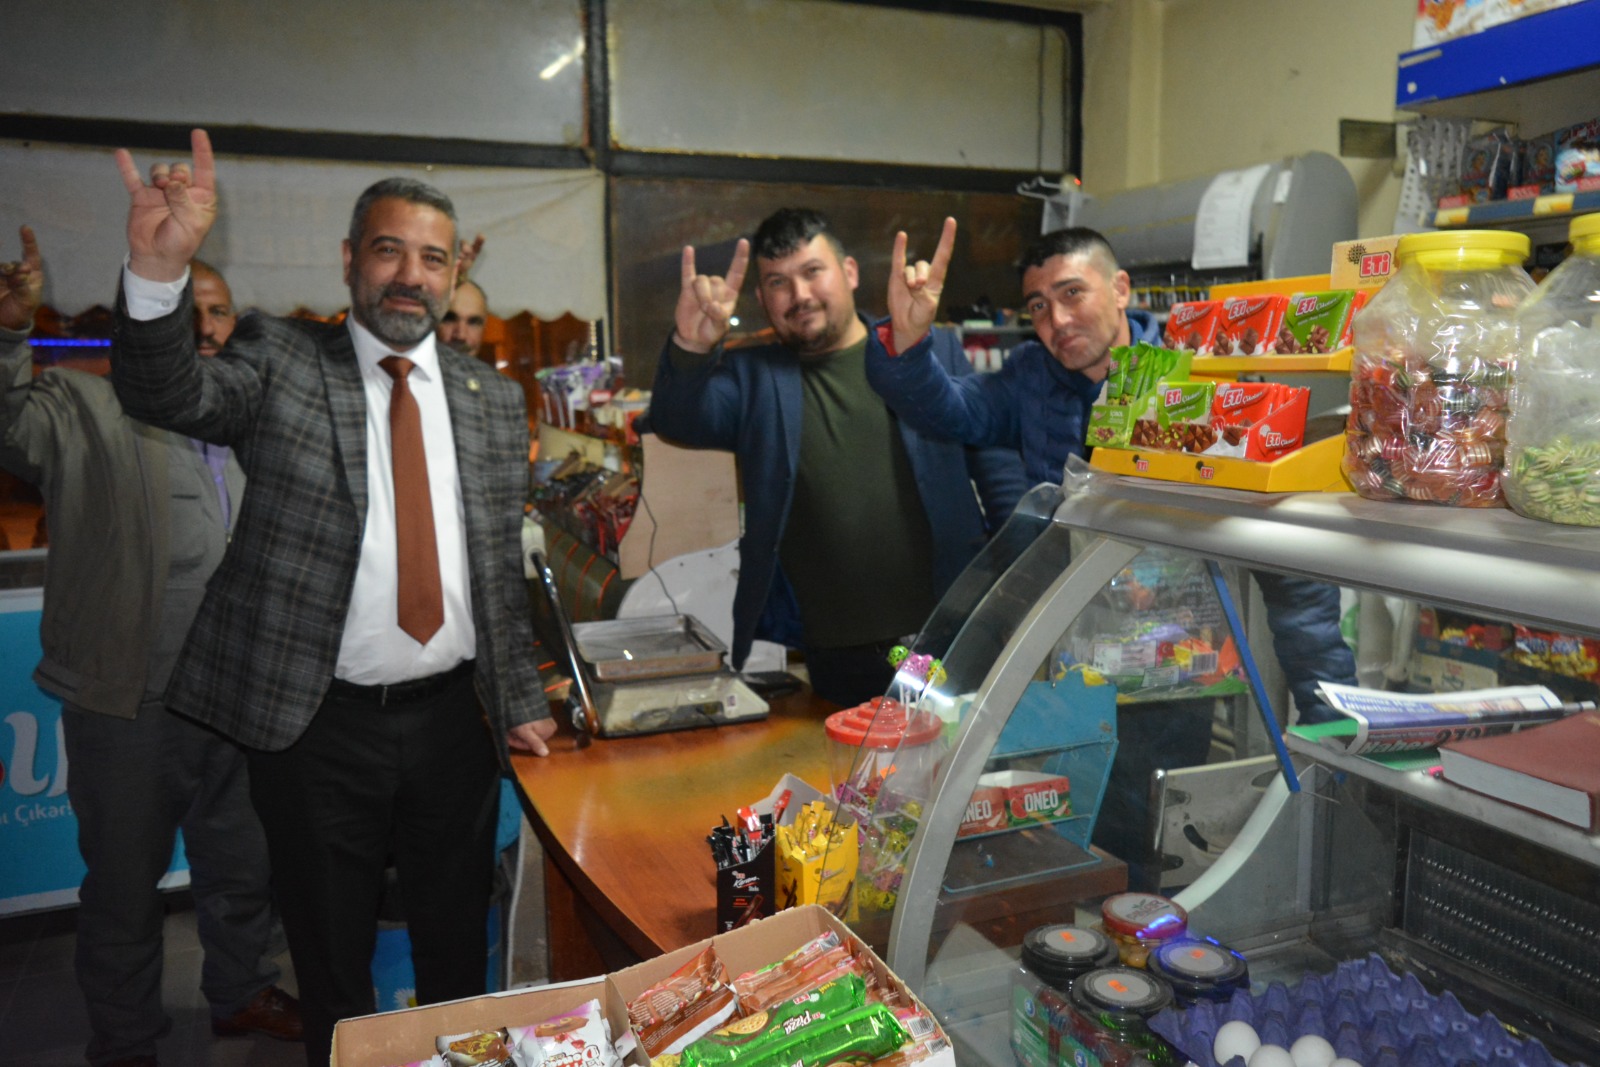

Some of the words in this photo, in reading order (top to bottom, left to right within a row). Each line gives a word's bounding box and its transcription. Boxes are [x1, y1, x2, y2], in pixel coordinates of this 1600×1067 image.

[962, 800, 992, 823] NEO
[1024, 789, 1058, 812] ONEO
[15, 800, 73, 826] Çıkar!
[783, 1010, 812, 1035] Pizza
